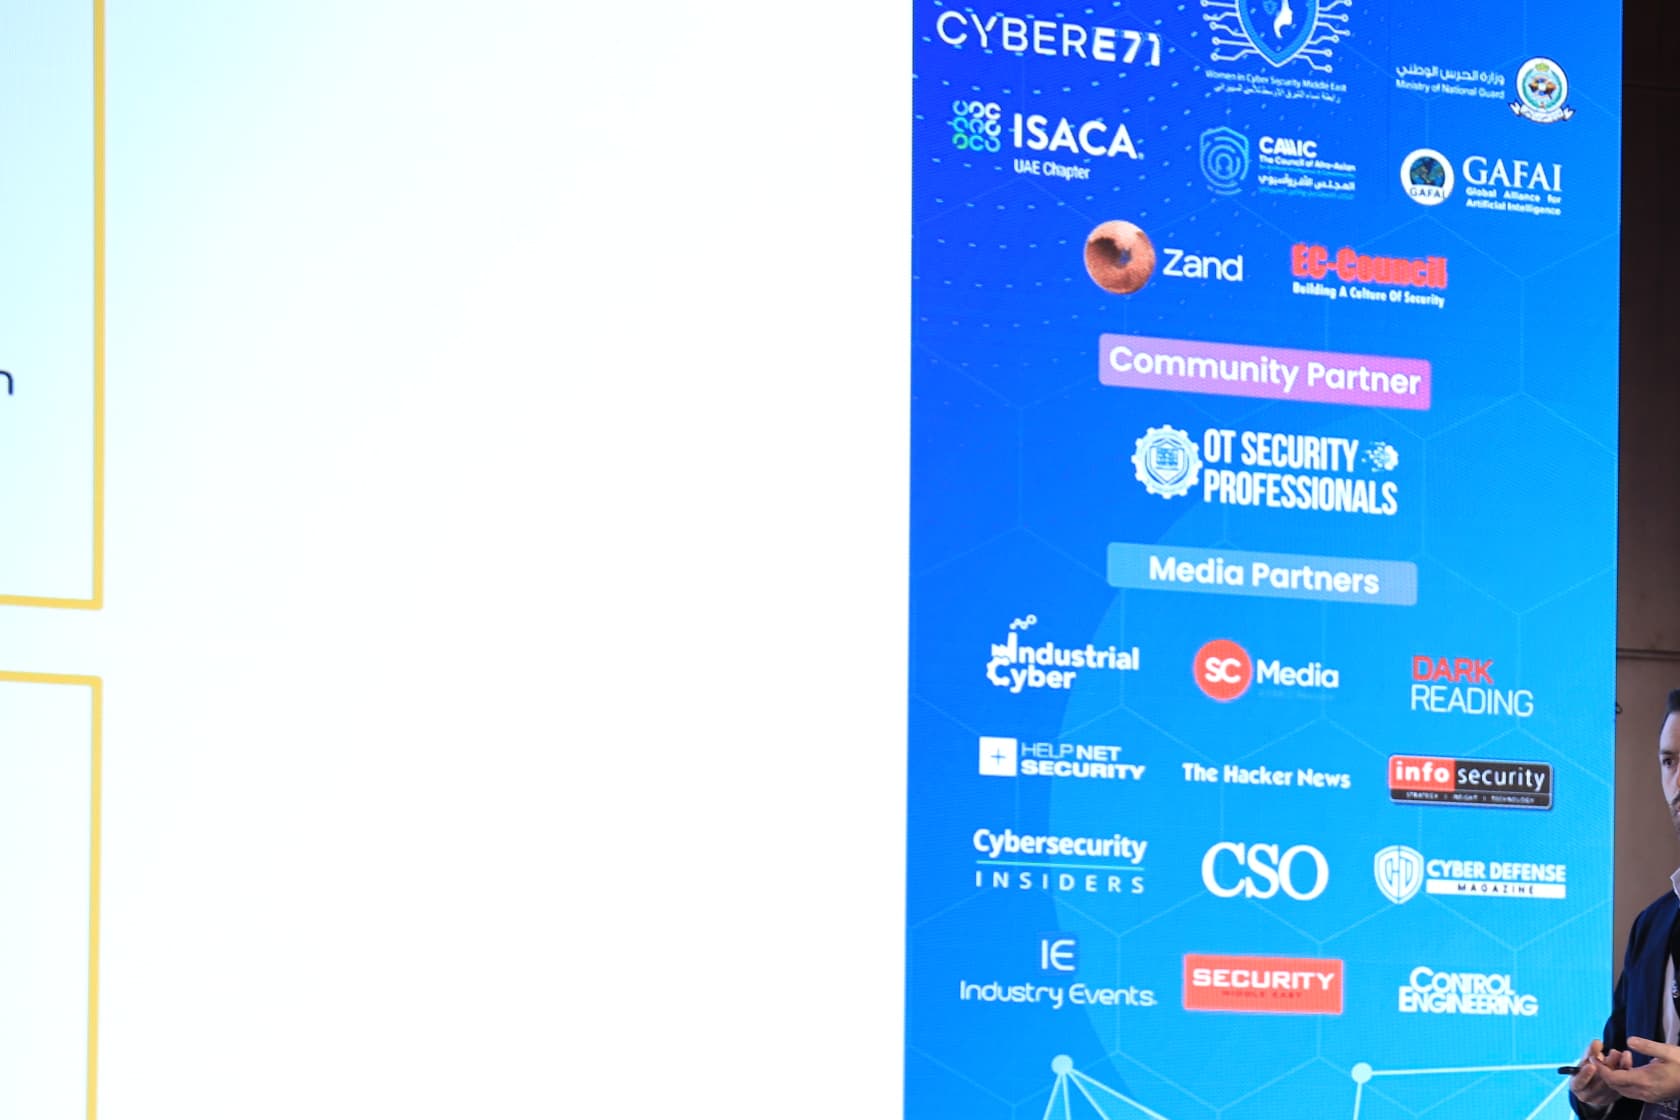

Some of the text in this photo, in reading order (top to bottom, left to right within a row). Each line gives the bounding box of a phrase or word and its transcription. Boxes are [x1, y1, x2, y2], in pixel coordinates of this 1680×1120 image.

[1205, 70, 1237, 80] Women
[1246, 73, 1269, 84] Cyber
[1270, 76, 1301, 88] Security
[1302, 79, 1329, 90] Middle
[1330, 82, 1347, 92] East
[1396, 63, 1505, 86] وزارة الحرس الوطني
[1396, 79, 1505, 99] Ministry of National Guard
[1014, 159, 1090, 180] UAE Chapter
[1259, 154, 1274, 164] The
[1274, 156, 1305, 167] Council
[1314, 160, 1356, 171] Afro-Asian
[1462, 155, 1563, 192] GAFAI
[1465, 186, 1562, 204] Global Alliance for
[1465, 198, 1562, 216] Artificial Intelligence
[1162, 247, 1244, 282] Zand
[1291, 243, 1448, 289] EC-Council
[1292, 281, 1445, 309] Building A Culture Of Security
[1109, 346, 1422, 395] Community Partner
[1203, 428, 1237, 464] OT
[1241, 430, 1359, 473] SECURITY
[1203, 468, 1398, 516] PROFESSIONALS
[1149, 555, 1380, 595] Media Partners
[1007, 631, 1140, 670] Industrial
[986, 656, 1077, 694] Cyber
[1204, 656, 1340, 689] SC Media
[1412, 654, 1494, 684] DARK
[1410, 683, 1535, 718] READING
[1020, 742, 1122, 762] HELP NET
[1020, 758, 1146, 780] SECURITY
[1182, 762, 1352, 790] The Hacker News
[972, 827, 1148, 865] Cybersecurity
[975, 869, 1145, 895] INSIDERS
[1201, 841, 1330, 901] CSO
[1426, 859, 1567, 883] CYBER DEFENSE
[1457, 883, 1534, 895] MAGAZINE
[1192, 967, 1335, 991] SECURITY
[959, 979, 1064, 1010] Industry
